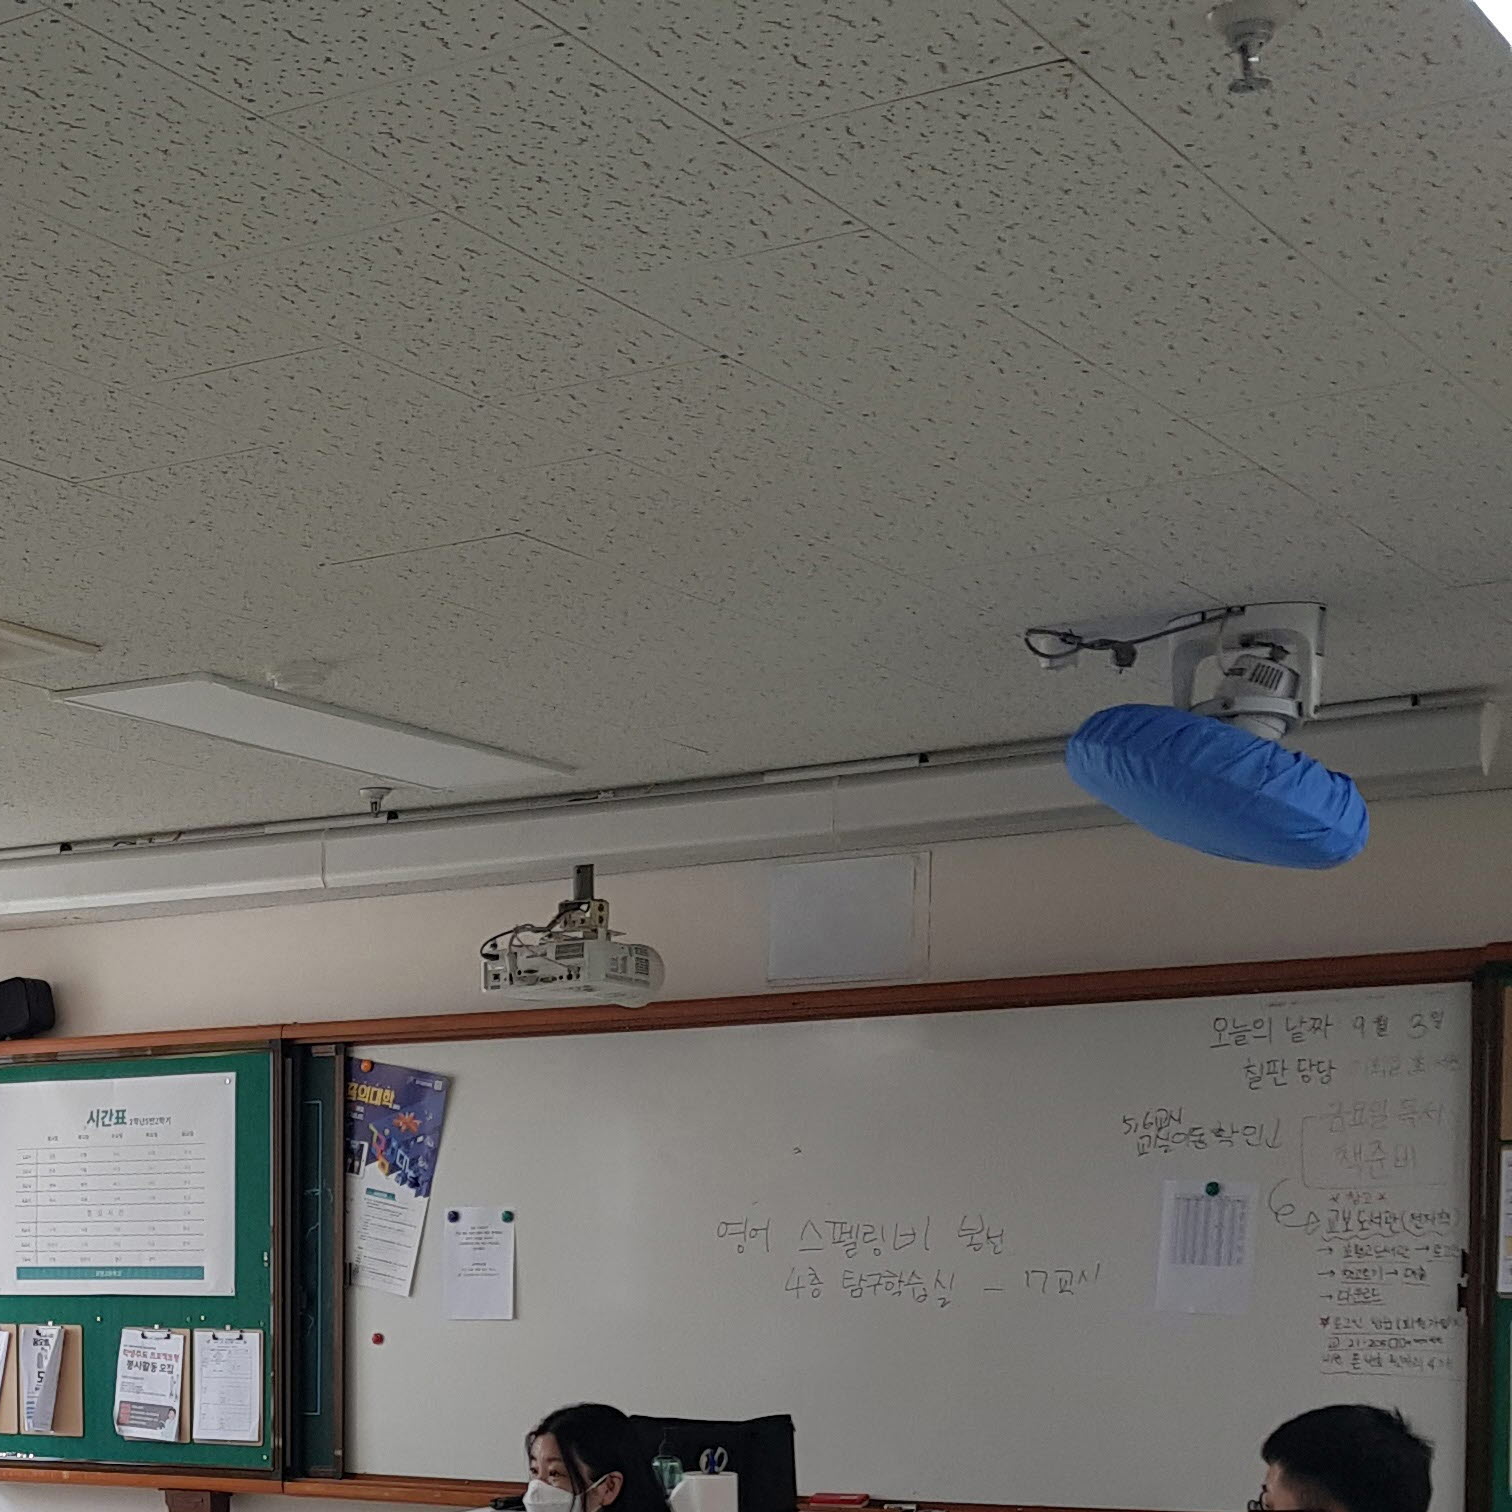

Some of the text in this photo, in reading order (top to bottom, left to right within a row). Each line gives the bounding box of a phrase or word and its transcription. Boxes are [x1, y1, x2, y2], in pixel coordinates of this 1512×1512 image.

[1210, 1015, 1272, 1048] 오늘의
[1286, 1014, 1333, 1043] 날짜
[1243, 1058, 1288, 1090] 칠판
[87, 1109, 127, 1128] 시간표
[716, 1216, 771, 1254] 영어
[797, 1214, 930, 1259] 스펠링비
[784, 1266, 824, 1299] 4층
[842, 1267, 956, 1308] 탐구학습실
